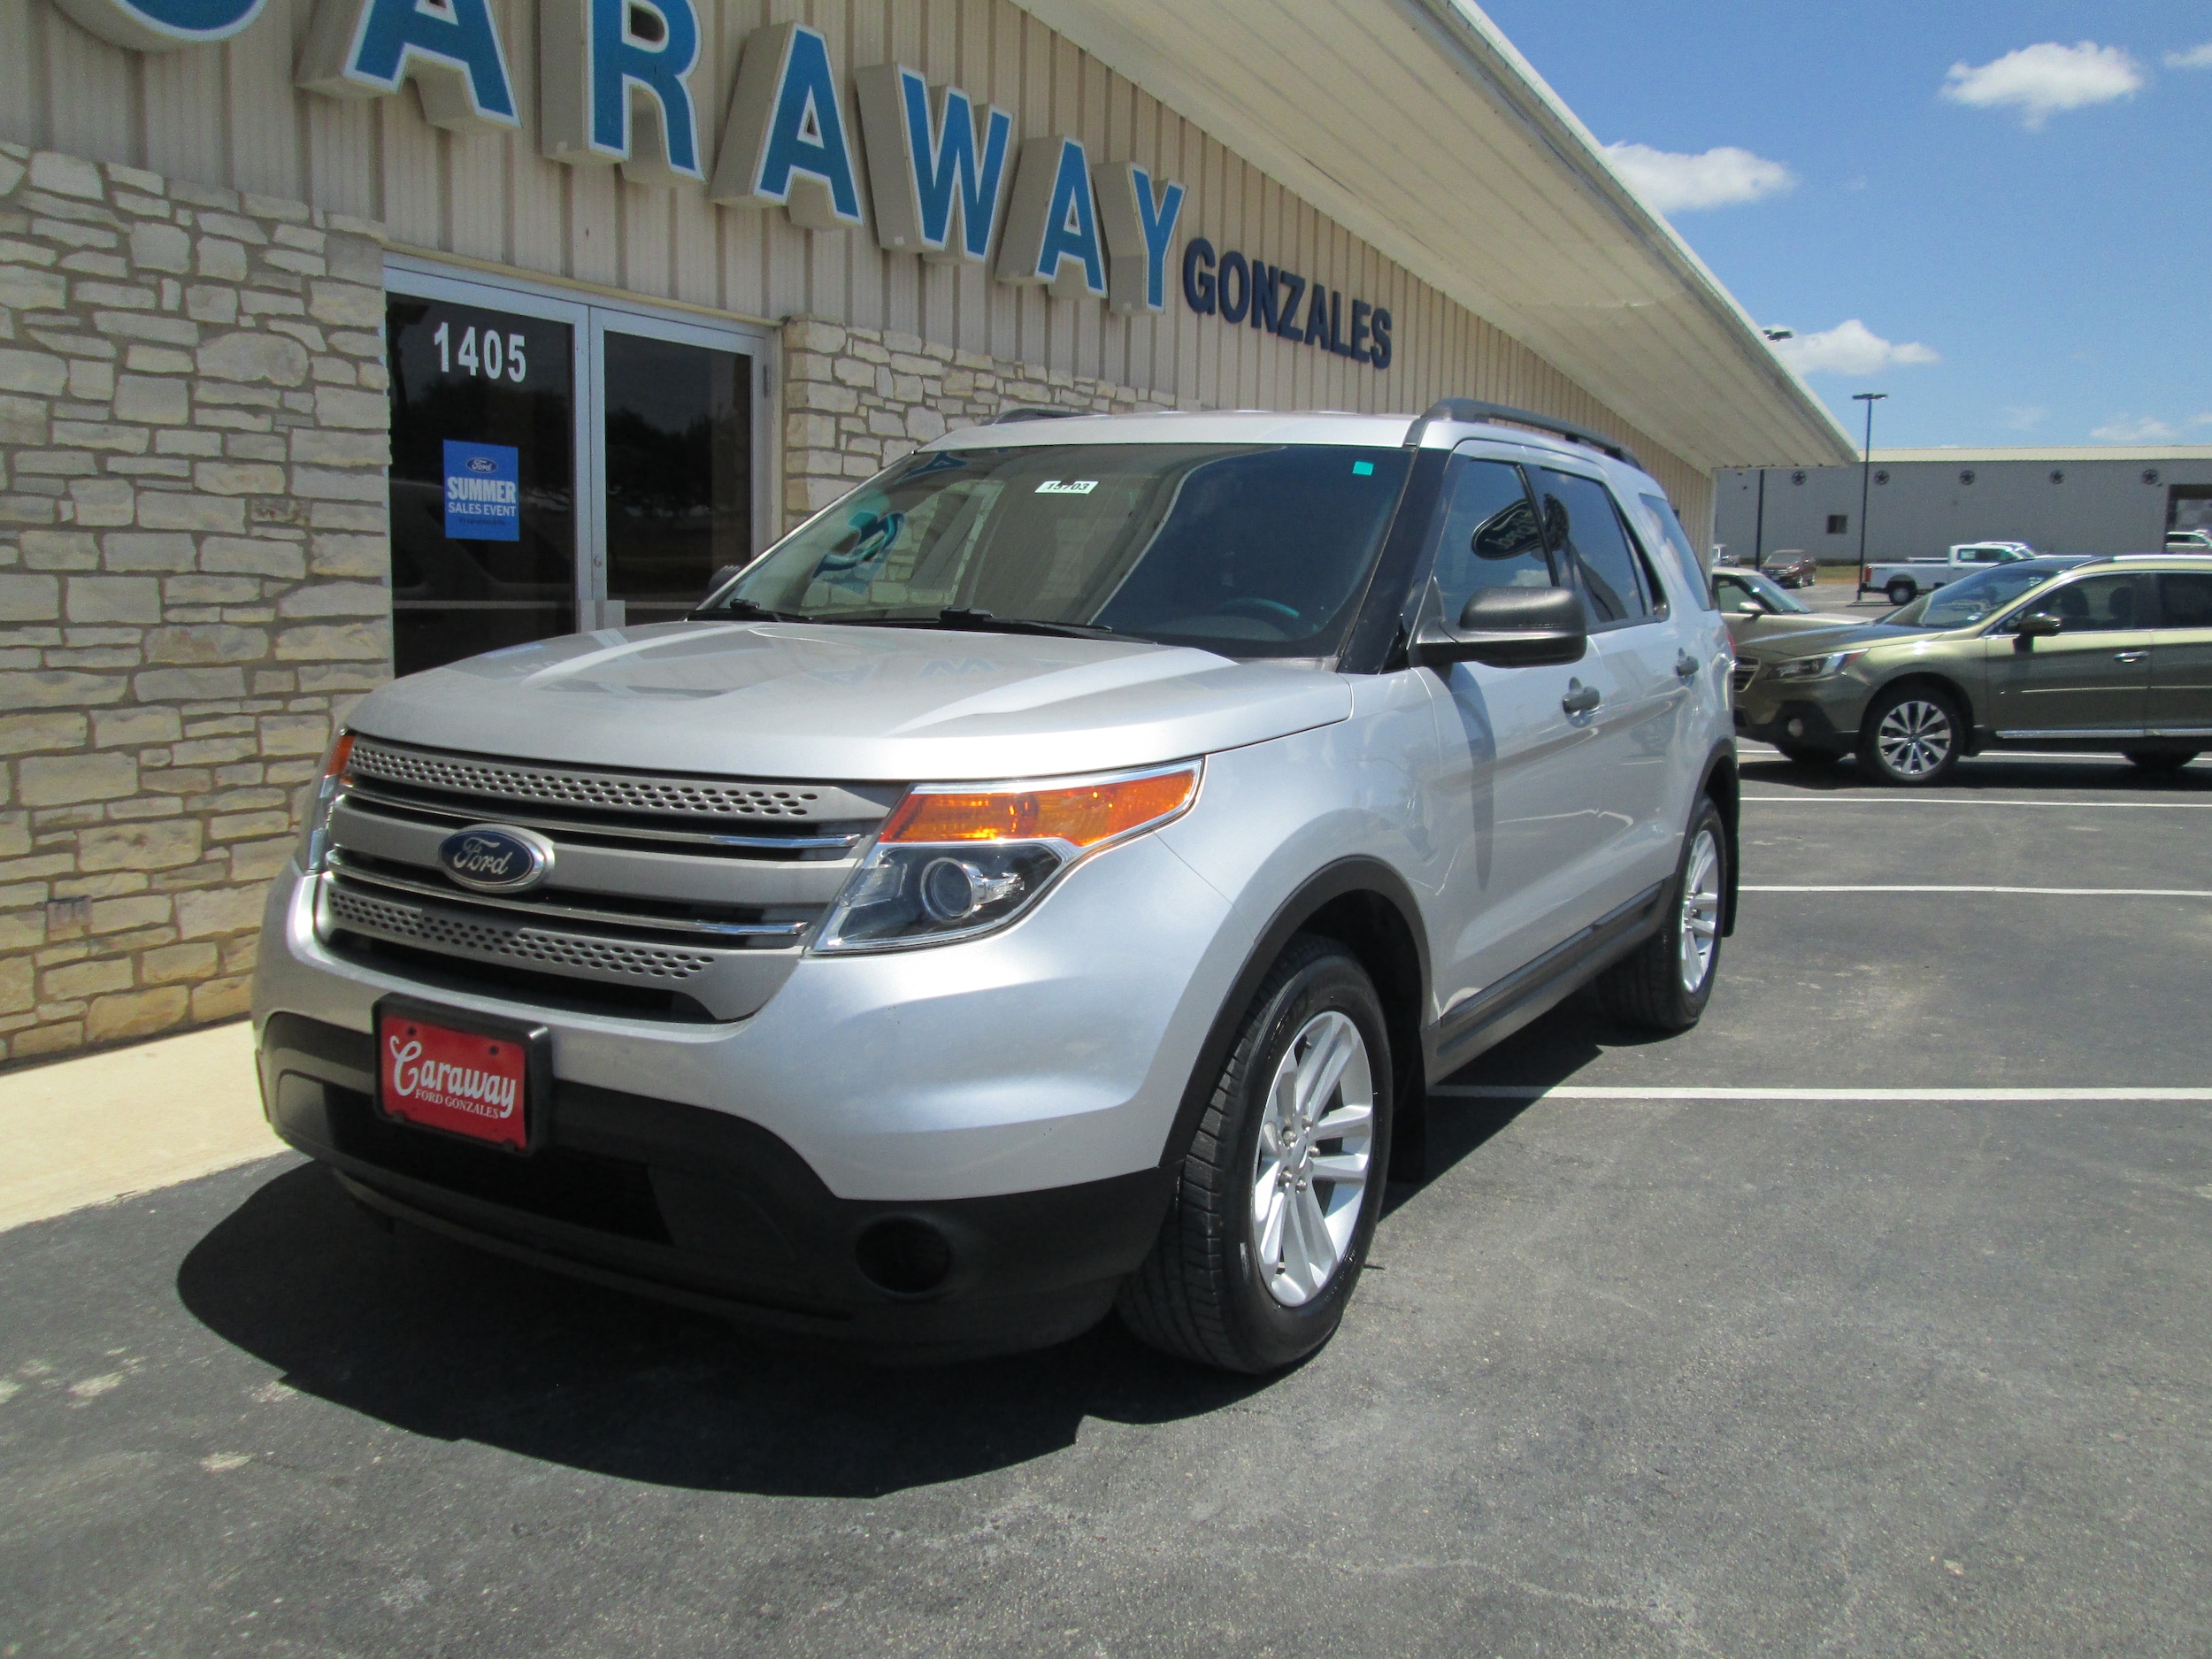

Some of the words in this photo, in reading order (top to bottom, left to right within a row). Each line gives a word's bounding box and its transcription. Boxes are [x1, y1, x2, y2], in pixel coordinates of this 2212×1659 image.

[111, 0, 1187, 313] ARAWAY
[1183, 237, 1392, 369] GONZALES
[434, 321, 526, 383] 1405
[470, 457, 493, 472] Ford
[447, 476, 517, 503] SUMMER
[448, 501, 482, 515] SALES
[483, 504, 517, 517] EVENT
[453, 836, 513, 875] Ford
[389, 1035, 516, 1118] Caraway
[415, 1088, 443, 1104] FORD
[444, 1096, 499, 1119] GONZALES
